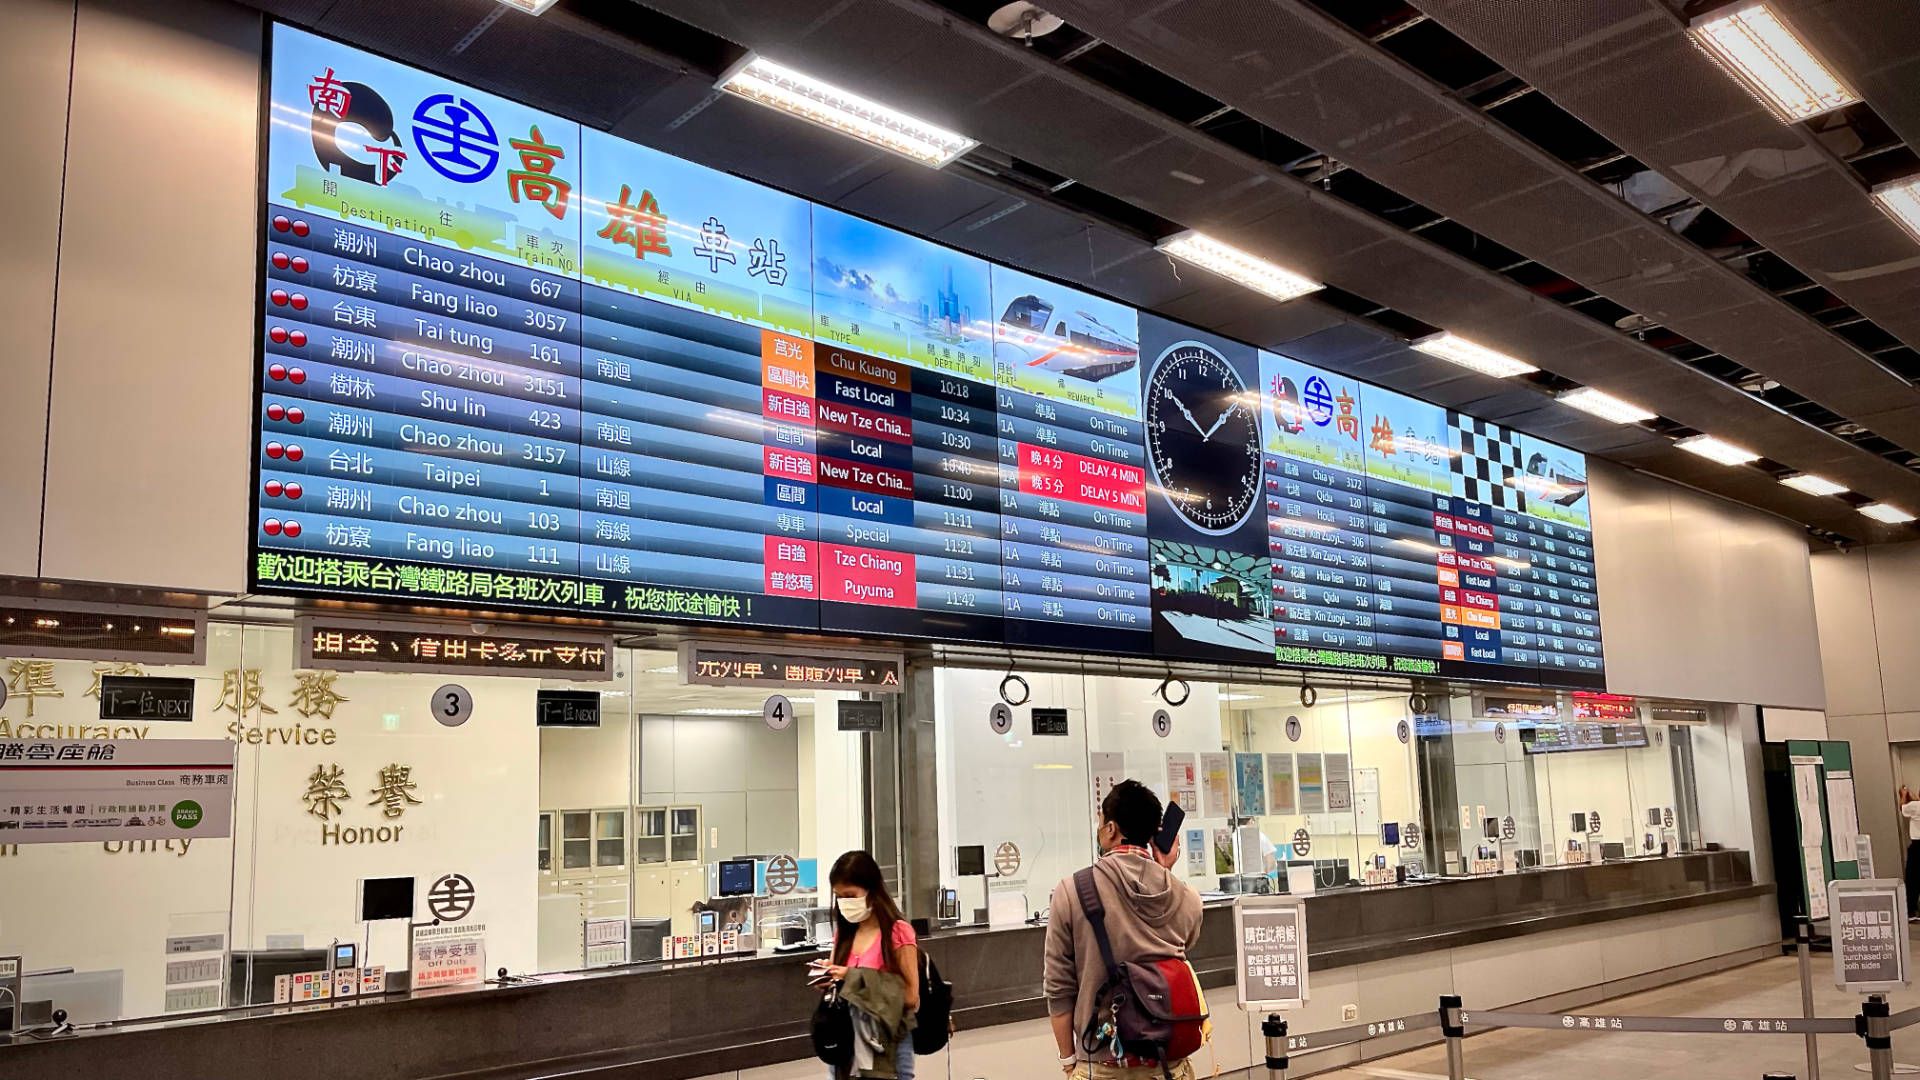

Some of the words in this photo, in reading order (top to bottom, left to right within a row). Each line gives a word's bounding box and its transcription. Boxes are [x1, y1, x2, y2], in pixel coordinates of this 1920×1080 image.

[507, 124, 788, 287] 高雄車站
[340, 200, 436, 237] Destination
[333, 227, 377, 258] 潮州
[403, 246, 453, 274] Chao
[460, 264, 506, 287] zhou
[516, 245, 553, 265] Train
[558, 256, 573, 271] NO
[333, 264, 378, 294] 枋寮
[530, 278, 562, 299] 667
[657, 270, 706, 294] 經由
[411, 283, 458, 313] Fang
[465, 294, 498, 318] liao
[673, 288, 692, 303] VIA
[332, 301, 377, 328] 台東
[524, 309, 567, 334] 3057
[415, 318, 443, 340] Tai
[450, 327, 493, 354] tung
[830, 330, 851, 345] TYPE
[331, 335, 375, 365] 潮州
[529, 343, 561, 365] 161
[774, 338, 802, 360] 莒光
[402, 352, 452, 377] Chao
[459, 364, 505, 387] zhou
[597, 358, 631, 382] 南迴
[767, 366, 810, 391] 區間快
[831, 353, 854, 374] Chu
[857, 360, 897, 384] Kuang
[330, 372, 376, 400] 樹林
[524, 375, 567, 398] 3151
[835, 381, 860, 400] Fast
[864, 388, 894, 407] Local
[940, 379, 969, 399] 10:18
[421, 390, 458, 413] Shu
[463, 395, 486, 418] lin
[768, 394, 811, 418] 新自強
[1000, 394, 1014, 410] 1A
[328, 411, 373, 439] 潮州
[529, 409, 561, 431] 423
[819, 406, 849, 425] New
[851, 411, 873, 430] Tze
[876, 416, 911, 438] Chia...
[940, 405, 970, 424] 10:34
[1089, 415, 1103, 430] On
[1106, 418, 1128, 436] Time
[399, 424, 451, 447] Chao
[457, 433, 503, 456] zhou
[597, 423, 631, 445] 南迴
[776, 425, 805, 447] 區間
[941, 431, 971, 451] 10:30
[522, 443, 566, 465] 3157
[850, 440, 882, 459] Local
[1002, 445, 1016, 461] 1A
[329, 449, 373, 475] 台北
[597, 456, 631, 477] 山線
[769, 453, 813, 477] 新自強
[1079, 460, 1109, 480] DELAY
[1111, 467, 1118, 480] 4
[1119, 469, 1141, 485] MIN.
[423, 462, 481, 489] Taipei
[1346, 477, 1362, 490] 3172
[327, 485, 372, 512] 潮州
[539, 480, 549, 496] 1
[595, 487, 631, 510] 南迴
[776, 484, 805, 505] 區間
[943, 484, 973, 502] 11:00
[1080, 484, 1110, 504] DELAY
[1112, 490, 1119, 504] 5
[1120, 493, 1142, 508] MIN.
[398, 495, 450, 518] Chao
[456, 501, 502, 525] zhou
[852, 496, 883, 515] Local
[1349, 497, 1361, 509] 120
[528, 511, 560, 532] 103
[596, 519, 631, 542] 海線
[777, 514, 806, 533] 專車
[943, 511, 973, 530] 11:11
[1349, 517, 1364, 529] 3178
[326, 523, 372, 548] 枋寮
[406, 532, 453, 558] Fang
[460, 537, 494, 559] liao
[846, 524, 889, 545] Special
[1351, 535, 1364, 548] 306
[527, 545, 560, 565] 111
[778, 543, 807, 563] 自強
[944, 537, 974, 555] 11:21
[596, 554, 631, 575] 山線
[834, 550, 857, 569] Tze
[860, 554, 902, 575] Chiang
[945, 563, 975, 582] 11:31
[770, 572, 814, 592] 普悠瑪
[844, 580, 894, 600] Puyuma
[1354, 576, 1367, 588] 172
[945, 590, 976, 608] 11:42
[1006, 597, 1021, 612] 1A
[1097, 607, 1111, 620] On
[1114, 608, 1136, 624] Time
[105, 689, 155, 715] 下一位
[157, 699, 189, 717] NEXT
[213, 668, 351, 719] 服務
[444, 692, 460, 716] 3
[772, 702, 784, 722] 4
[996, 710, 1006, 727] 5
[1158, 715, 1166, 731] 6
[225, 722, 337, 745] Service
[1290, 721, 1297, 736] 7
[302, 762, 423, 820] 榮譽
[176, 813, 198, 821] PASS
[322, 823, 404, 846] Honor
[1843, 944, 1868, 952] Tickets
[1861, 961, 1881, 970] sides
[1578, 1016, 1623, 1030] 高雄站
[1742, 1019, 1788, 1032] 高雄站
